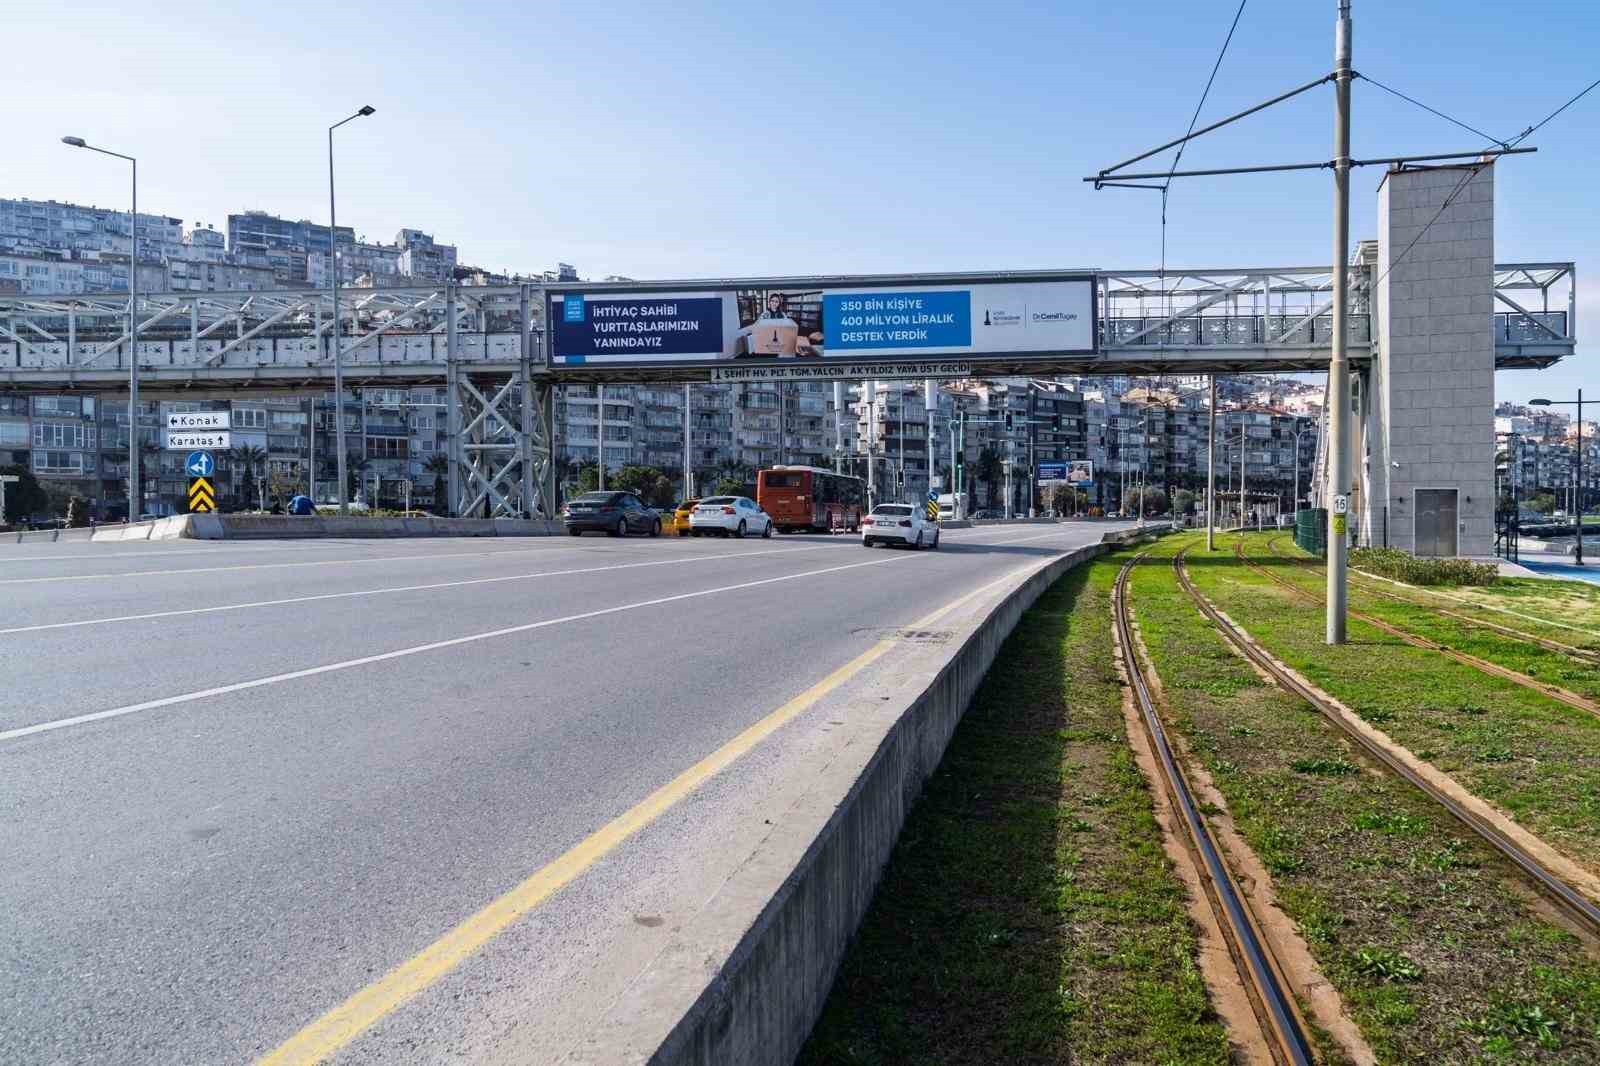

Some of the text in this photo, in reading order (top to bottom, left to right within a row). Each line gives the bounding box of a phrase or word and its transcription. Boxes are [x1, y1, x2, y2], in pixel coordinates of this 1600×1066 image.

[593, 304, 638, 317] İHTİYAÇ
[640, 303, 677, 316] SAHİBİ
[841, 297, 923, 311] 350 BİN KİŞİYE
[841, 312, 955, 326] 400 MİLYON LİRALIK
[592, 320, 699, 333] YURTTAŞLARIMIZIN
[841, 328, 928, 342] DESTEK VERDİK
[593, 336, 662, 348] YANINDAYIZ
[752, 367, 768, 377] HV.
[896, 364, 918, 374] YAYA
[180, 415, 219, 426] Konak
[169, 436, 214, 446] Karataş
